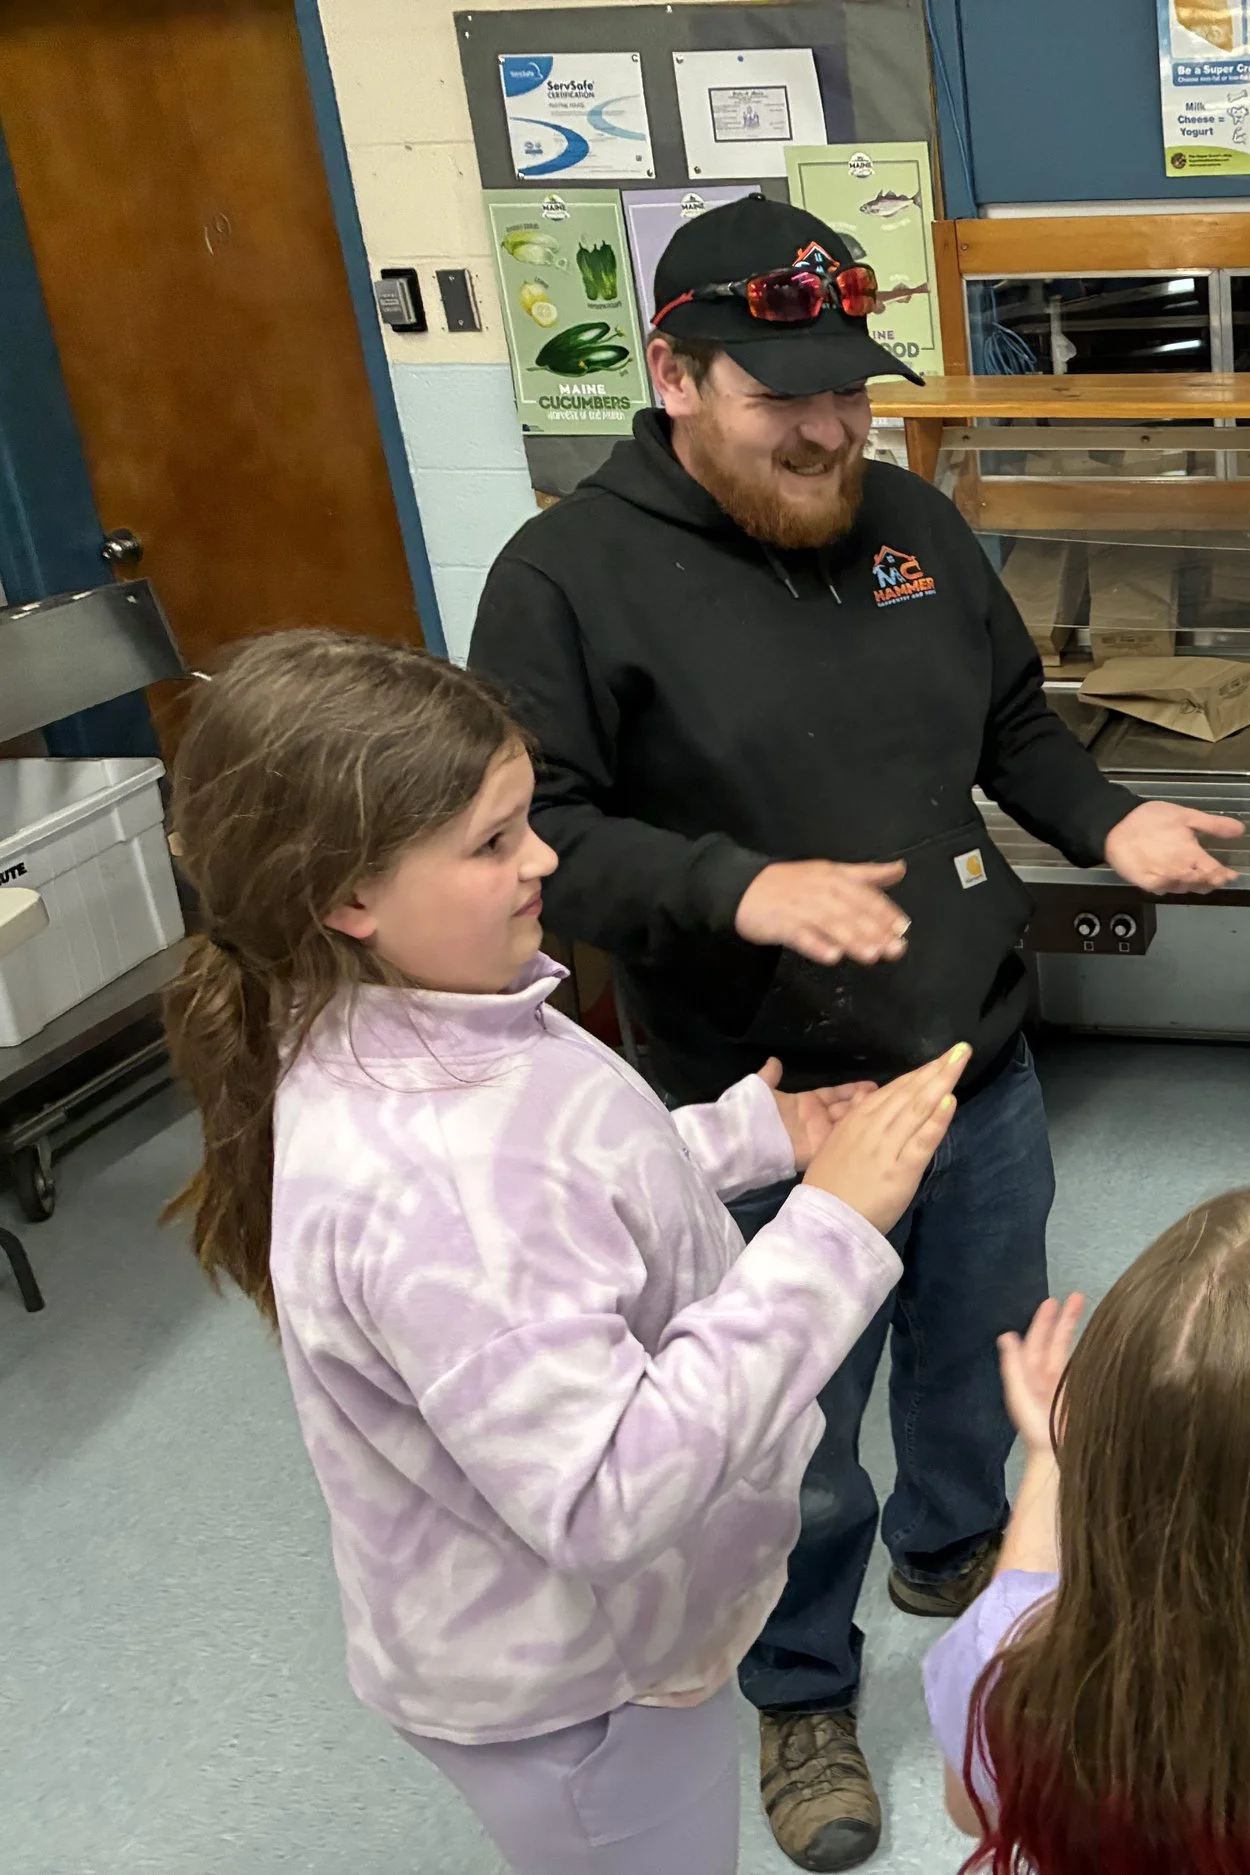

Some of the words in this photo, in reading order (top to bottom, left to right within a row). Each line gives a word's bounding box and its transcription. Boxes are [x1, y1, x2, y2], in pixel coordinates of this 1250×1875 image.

[1177, 65, 1191, 75] Be
[1203, 64, 1234, 75] Super
[547, 80, 594, 92] ServSafe
[547, 91, 595, 99] CERTIFICATION
[1185, 102, 1205, 111] Milk
[1177, 115, 1215, 124] Cheese
[1180, 127, 1214, 138] Yogurt
[542, 204, 567, 212] MAINE
[872, 330, 895, 340] INE
[558, 383, 607, 395] MAINE
[538, 395, 631, 410] CUCUMBERS
[873, 577, 936, 603] HAMMER
[0, 862, 28, 885] UTE
